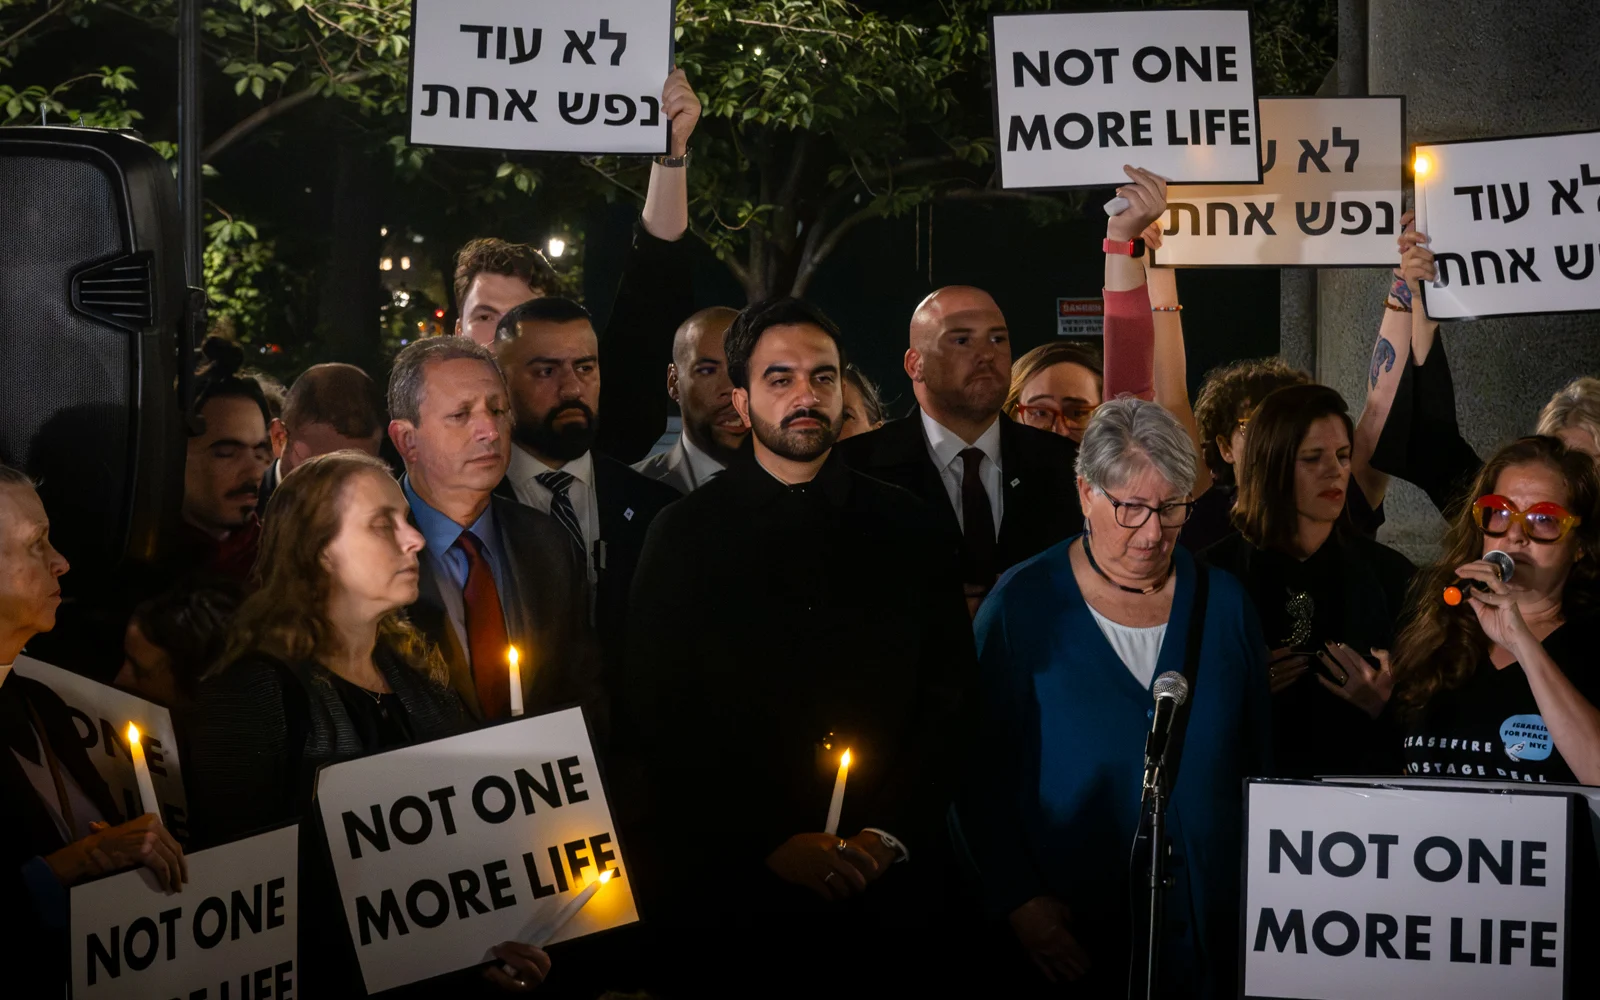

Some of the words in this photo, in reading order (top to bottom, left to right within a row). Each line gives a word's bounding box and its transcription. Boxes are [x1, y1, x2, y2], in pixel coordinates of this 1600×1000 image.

[459, 23, 543, 65] עוד
[562, 18, 628, 67] לא
[1012, 48, 1120, 88] NOT
[1132, 45, 1238, 84] ONE
[420, 83, 539, 123] אחת
[558, 91, 660, 127] נפש
[1007, 110, 1153, 152] MORE
[1166, 108, 1251, 147] LIFE
[1297, 126, 1360, 174] לא
[1163, 201, 1277, 237] אחת
[1295, 201, 1395, 237] נפש
[1453, 181, 1530, 224] עוד
[1432, 246, 1542, 289] אחת
[1522, 731, 1549, 741] PEACE
[1529, 741, 1548, 750] NYC
[1496, 767, 1547, 783] DEAL
[341, 785, 457, 860] NOT
[471, 755, 590, 824] ONE
[1268, 828, 1399, 880] NOT
[1413, 835, 1547, 888] ONE
[355, 859, 517, 947] MORE
[522, 832, 621, 901] LIFE
[86, 906, 182, 987] NOT
[192, 876, 286, 950] ONE
[1253, 907, 1432, 961] MORE
[1450, 916, 1558, 968] LIFE
